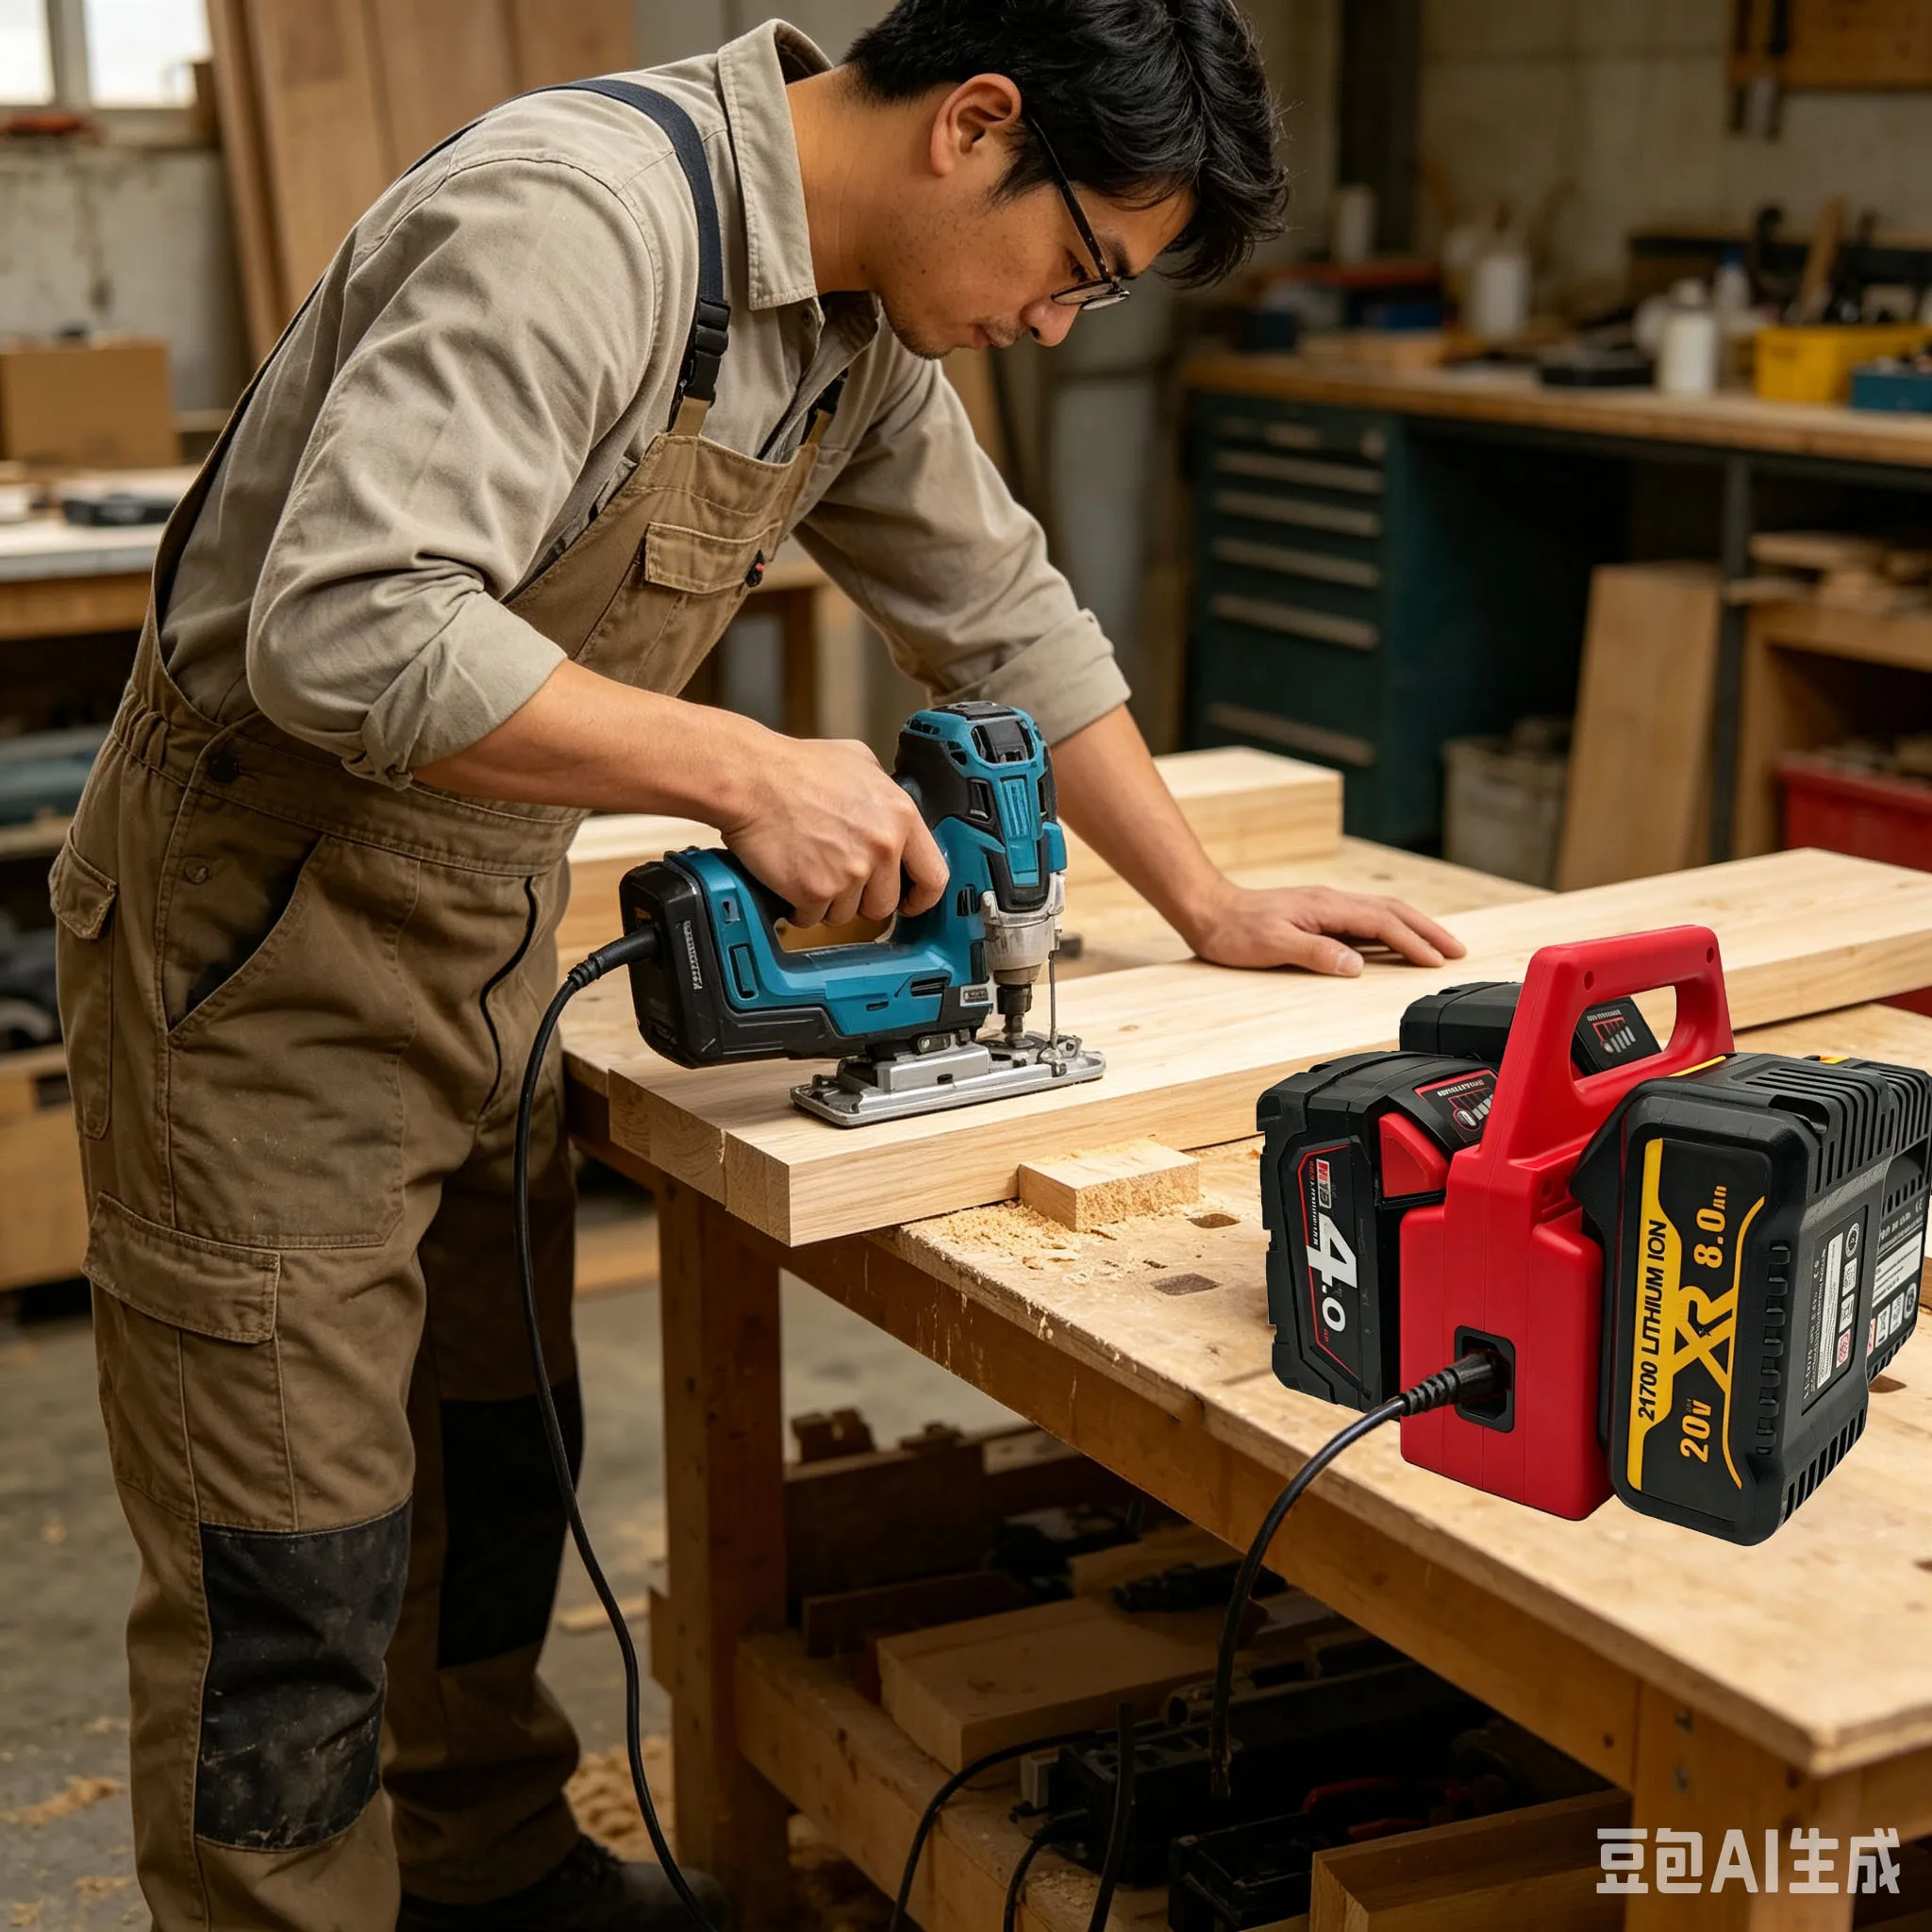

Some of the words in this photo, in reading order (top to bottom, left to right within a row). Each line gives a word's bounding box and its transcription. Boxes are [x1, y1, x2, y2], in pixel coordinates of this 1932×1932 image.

[1306, 1212, 1357, 1332] 4.0
[1647, 1219, 1667, 1261] ION
[1641, 1266, 1664, 1356] LITHIUM
[1674, 1285, 1735, 1392] XR
[1638, 1360, 1657, 1422] 21700
